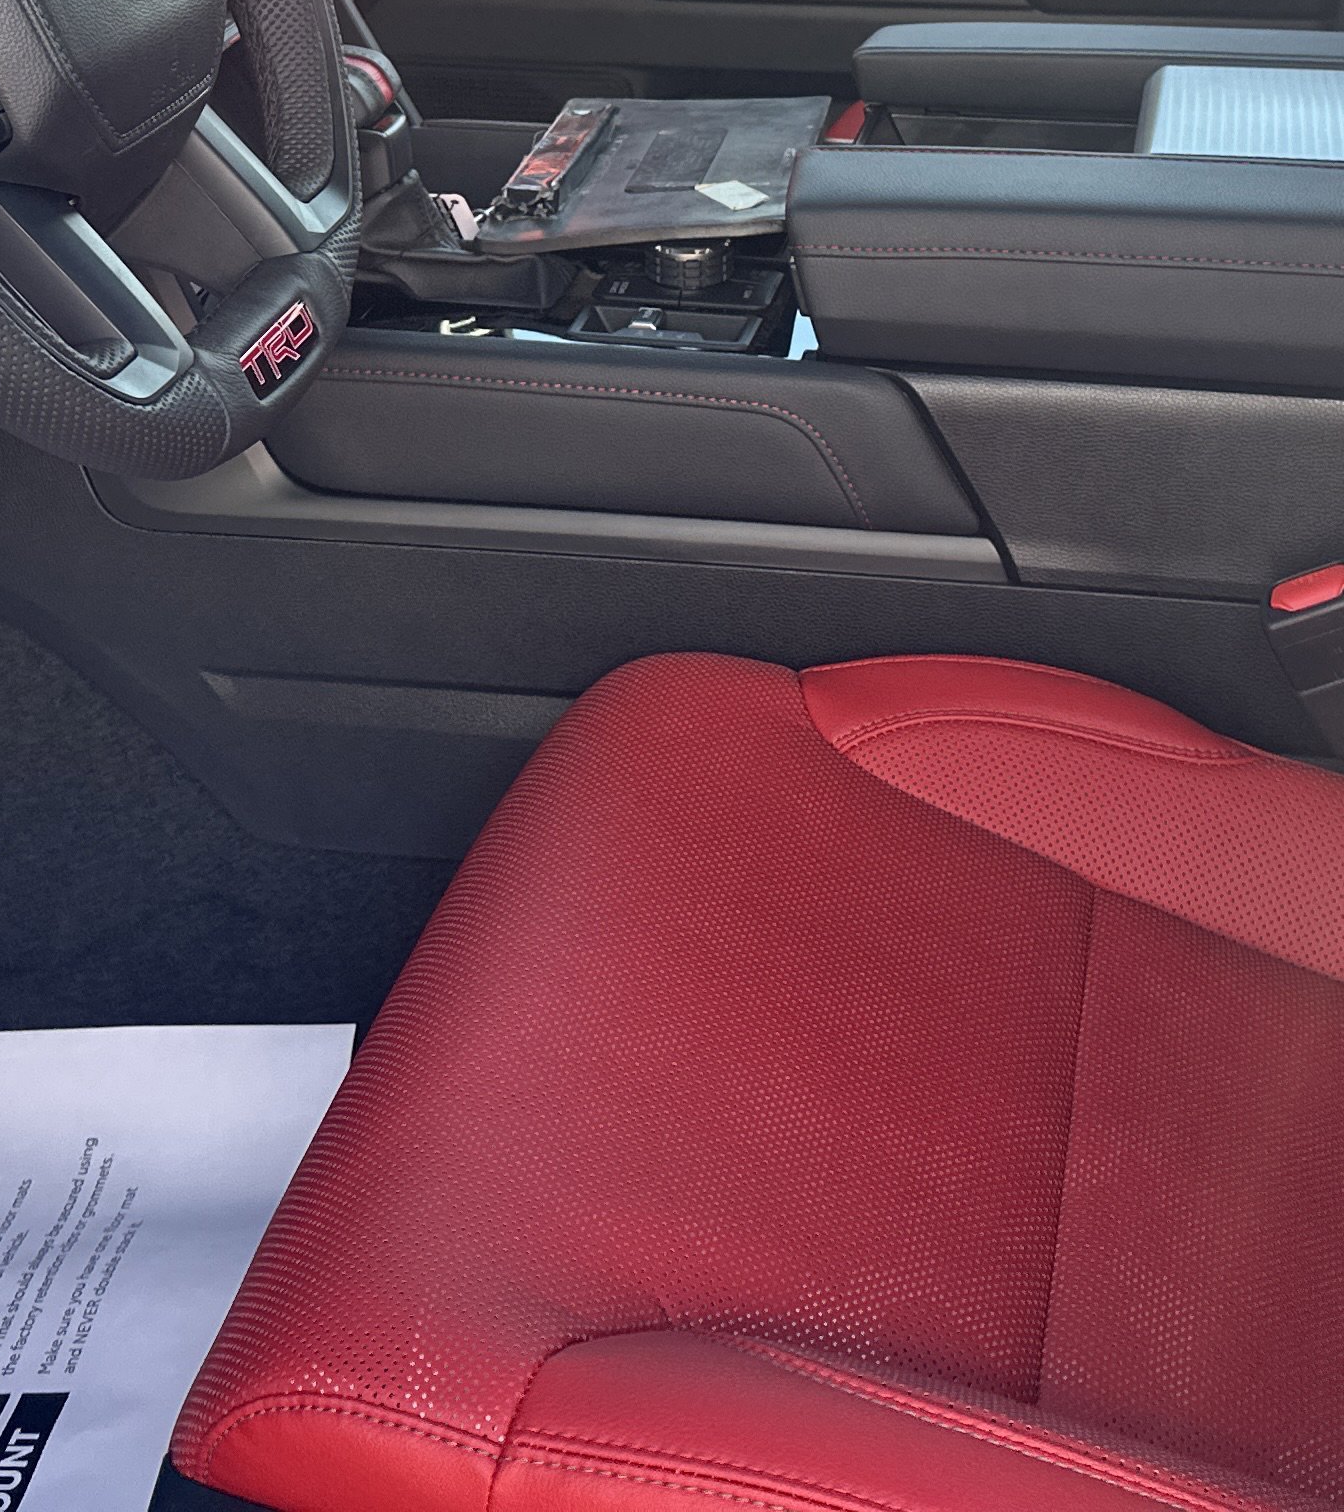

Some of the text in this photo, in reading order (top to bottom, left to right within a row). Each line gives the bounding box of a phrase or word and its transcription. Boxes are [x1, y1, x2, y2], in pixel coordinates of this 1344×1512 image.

[239, 299, 314, 386] TRD
[12, 1178, 32, 1208] mats
[7, 1272, 34, 1313] should
[78, 1137, 99, 1175] using
[38, 1339, 63, 1374] Make
[57, 1308, 75, 1336] sure
[69, 1282, 86, 1305] you
[121, 1186, 138, 1209] mat
[10, 1305, 43, 1350] factory
[72, 1298, 102, 1344] NEVER
[2, 1354, 21, 1376] the
[64, 1347, 82, 1374] and
